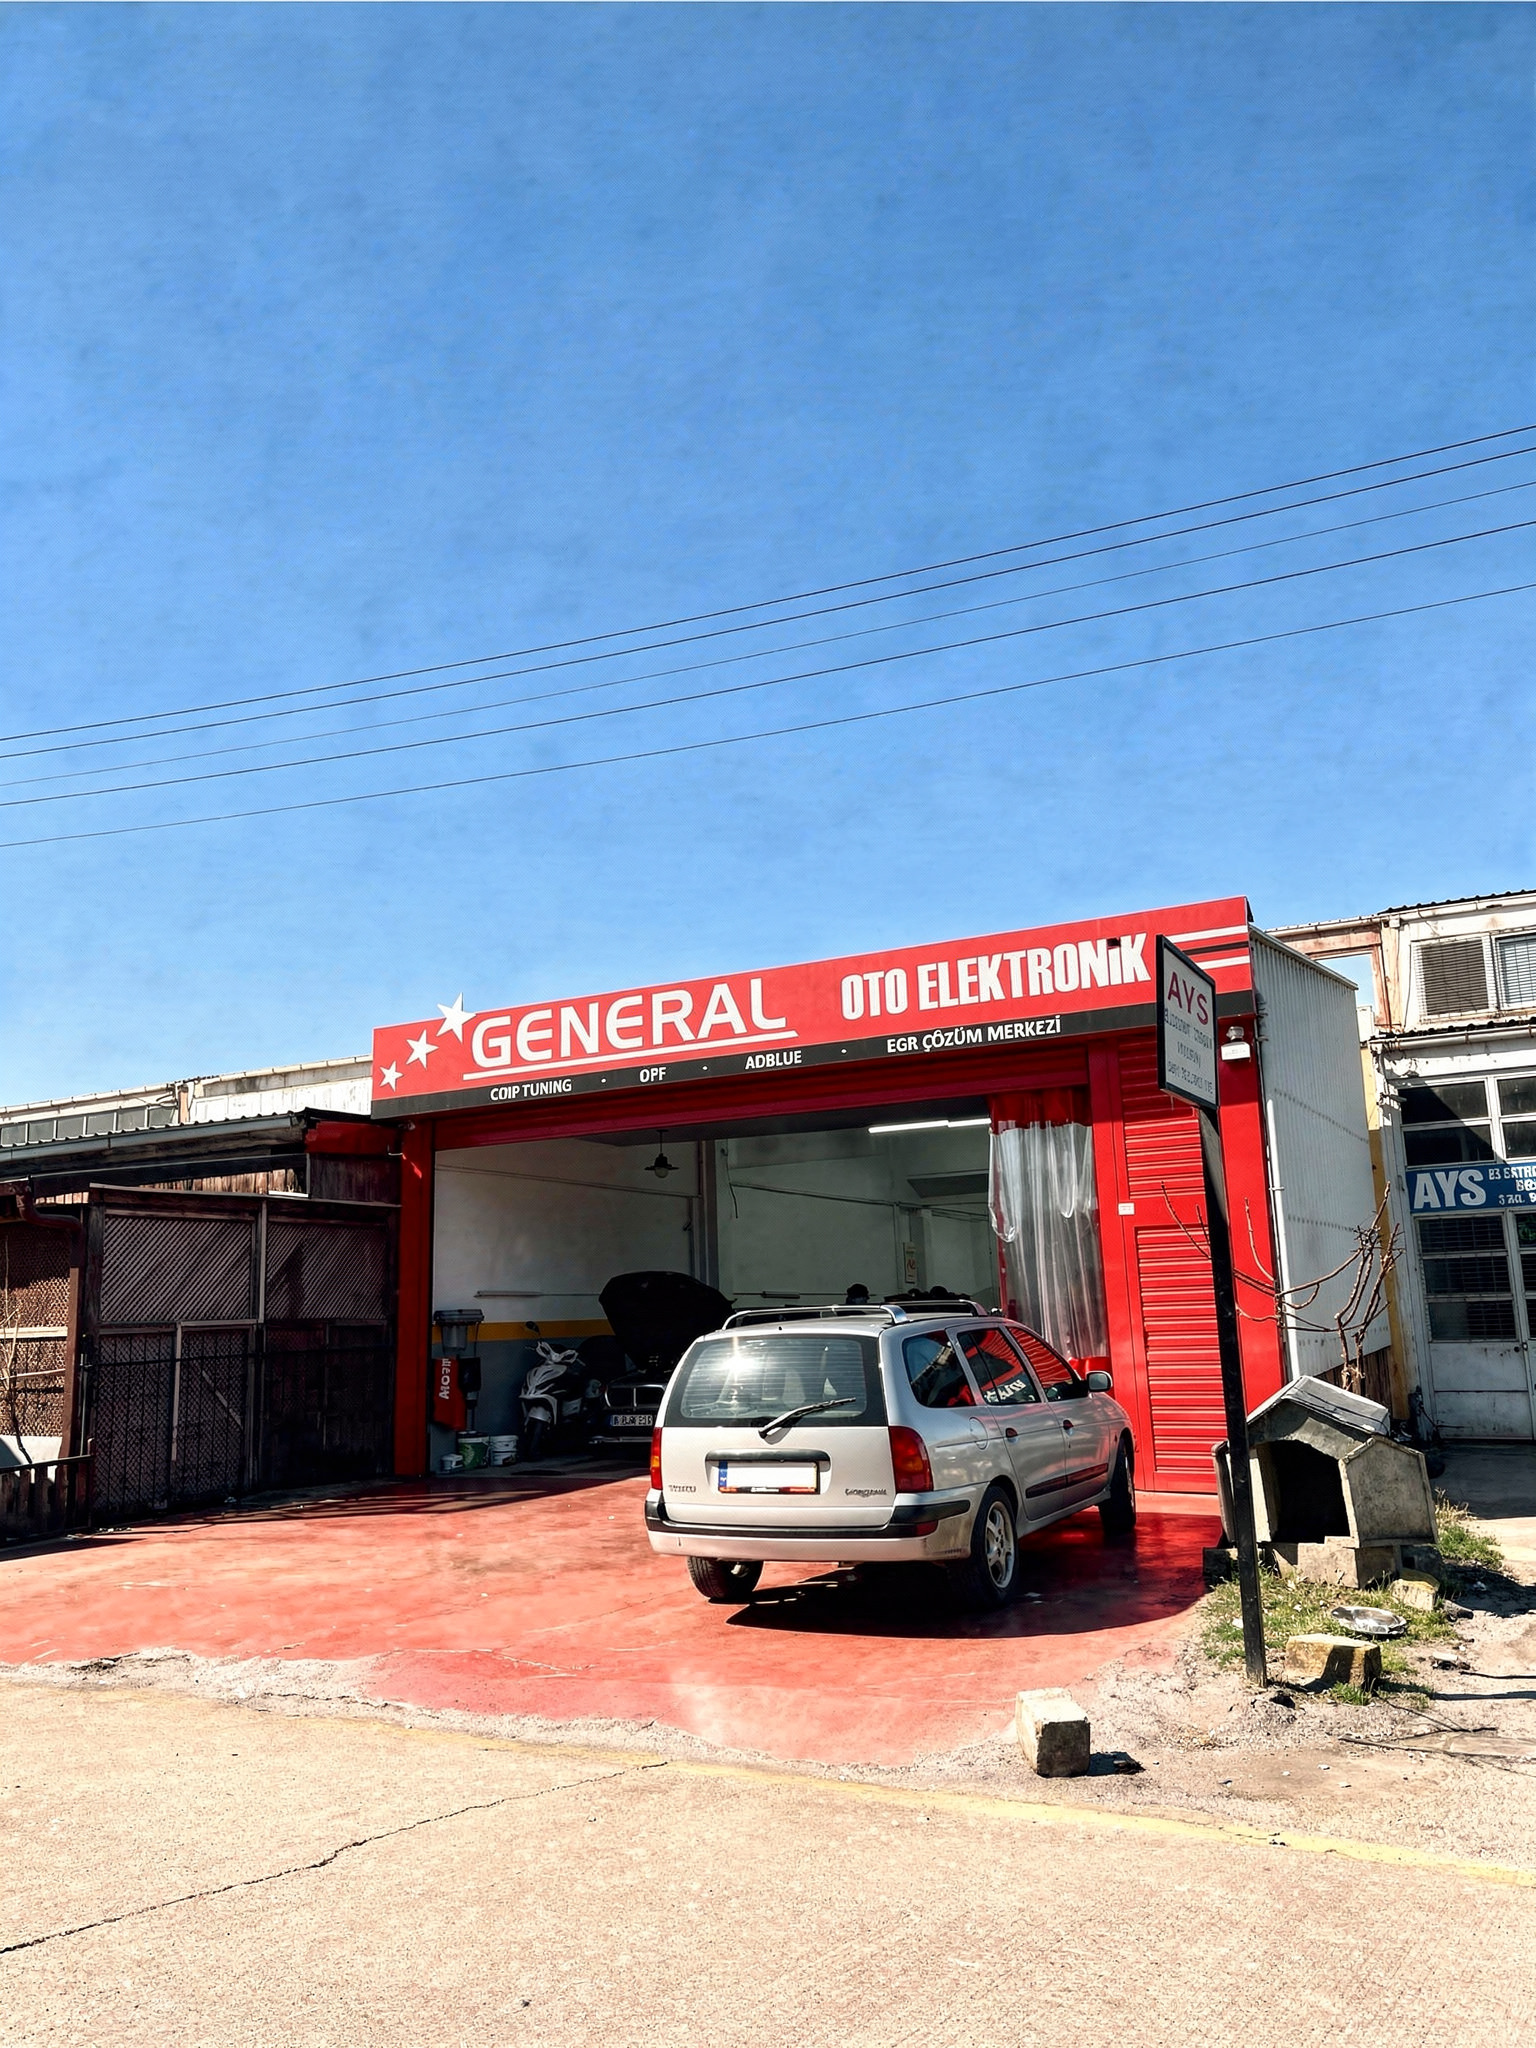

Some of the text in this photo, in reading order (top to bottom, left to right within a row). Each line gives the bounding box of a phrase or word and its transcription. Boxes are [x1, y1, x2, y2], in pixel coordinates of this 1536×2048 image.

[841, 968, 907, 1021] OTO
[1167, 971, 1209, 1025] AYS
[471, 978, 786, 1068] GENERAL
[745, 1050, 802, 1070] ADBLUE
[887, 1038, 919, 1054] EGR
[522, 1079, 572, 1097] TUNING
[1413, 1169, 1487, 1209] AYS
